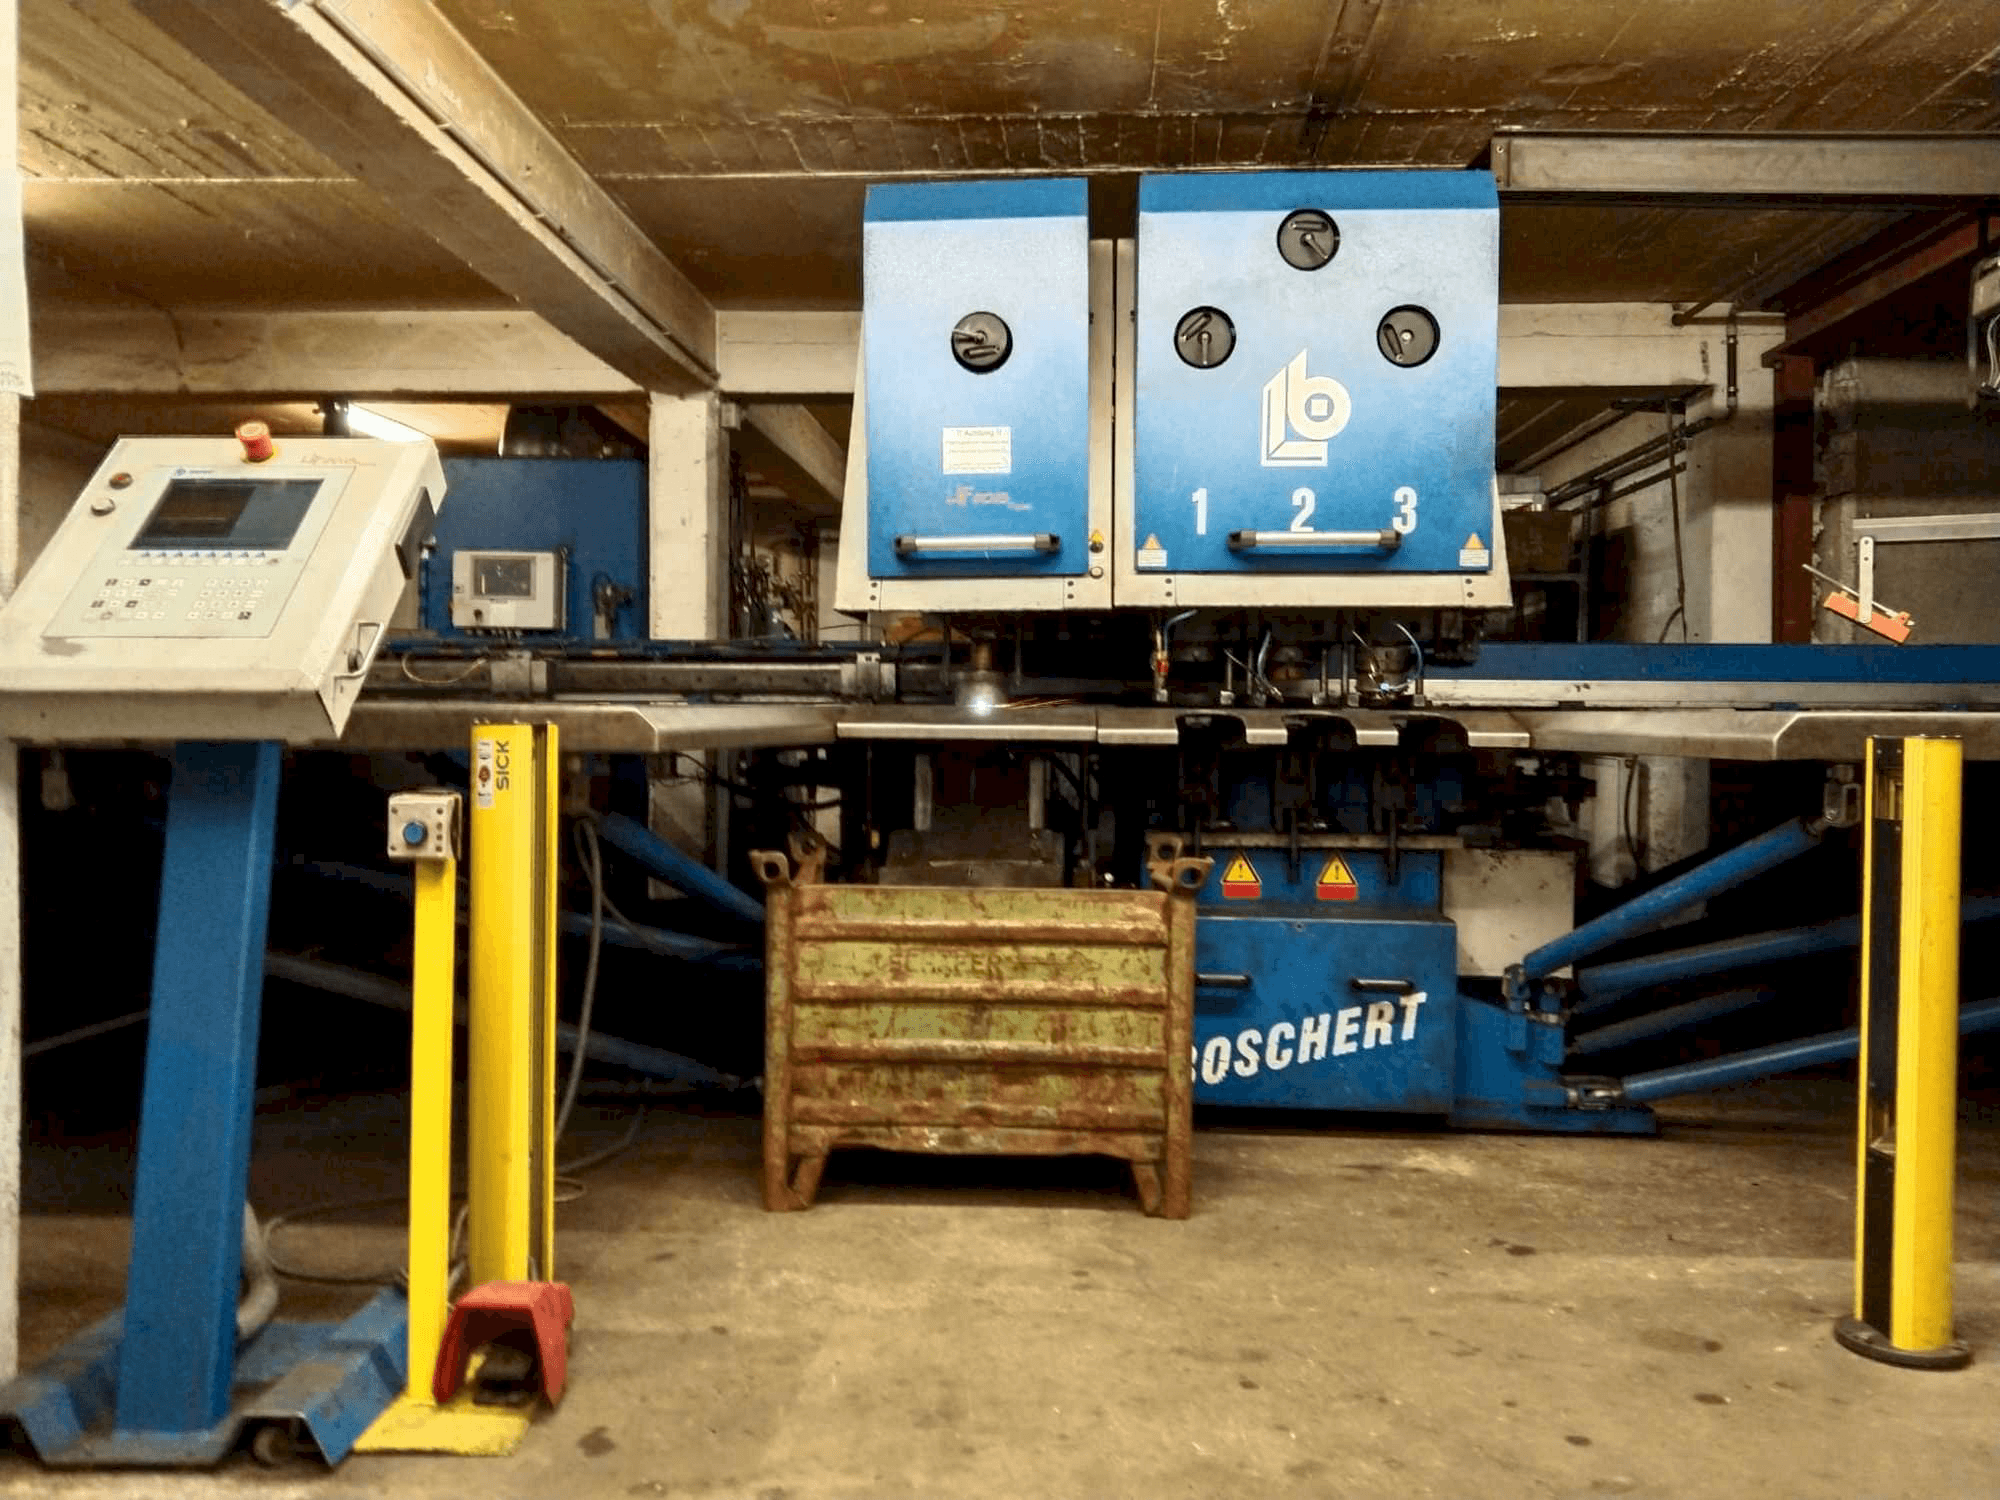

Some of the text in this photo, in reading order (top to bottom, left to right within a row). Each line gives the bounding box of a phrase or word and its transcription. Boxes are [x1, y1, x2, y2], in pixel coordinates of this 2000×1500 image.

[1191, 487, 1208, 535] 1
[1290, 486, 1316, 533] 2
[1392, 486, 1418, 535] 3
[496, 740, 510, 791] SICK
